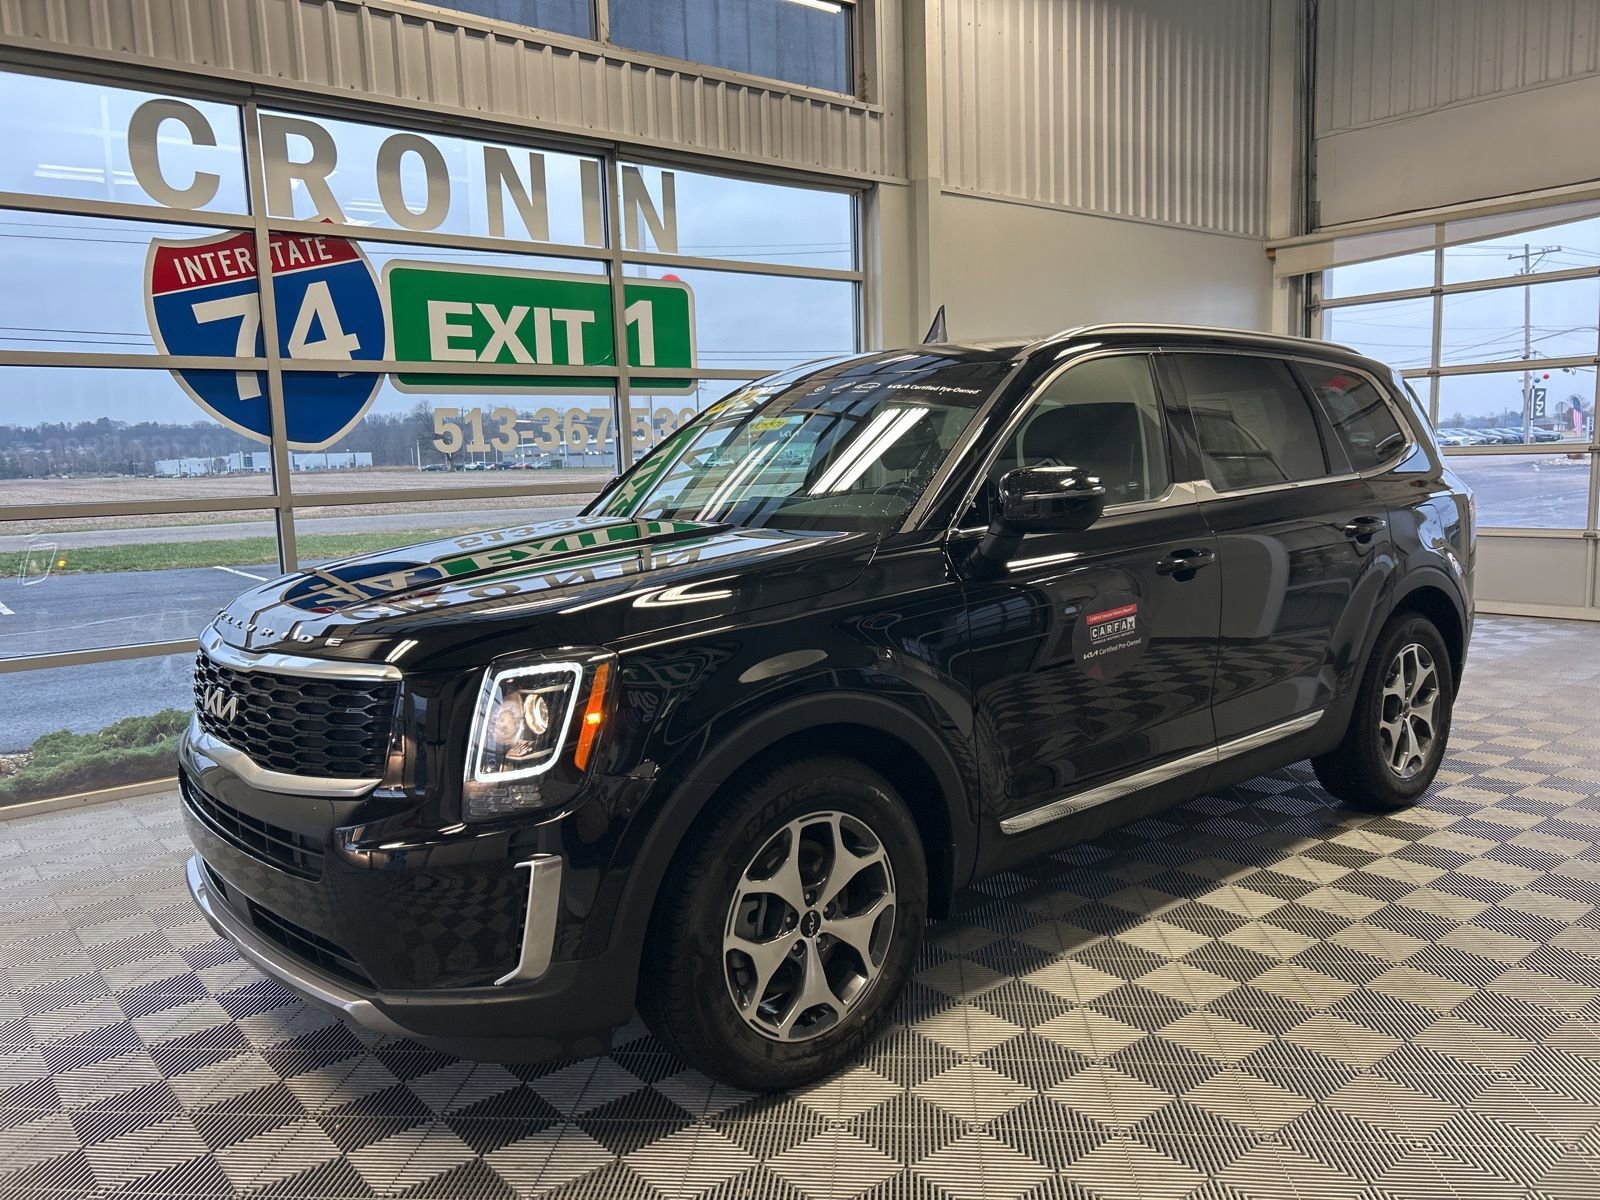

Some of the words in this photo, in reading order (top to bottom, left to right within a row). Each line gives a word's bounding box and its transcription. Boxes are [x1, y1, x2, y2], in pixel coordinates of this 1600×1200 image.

[128, 98, 679, 254] CRONIN
[173, 236, 333, 285] INTERTATE
[191, 280, 361, 401] 74
[427, 300, 595, 366] EXIT
[624, 300, 656, 367] 1
[1083, 650, 1099, 660] KIA
[1099, 644, 1118, 655] Certified
[1118, 637, 1142, 650] Pre-Owned
[1090, 615, 1136, 640] CARFAX
[204, 686, 239, 722] KIA
